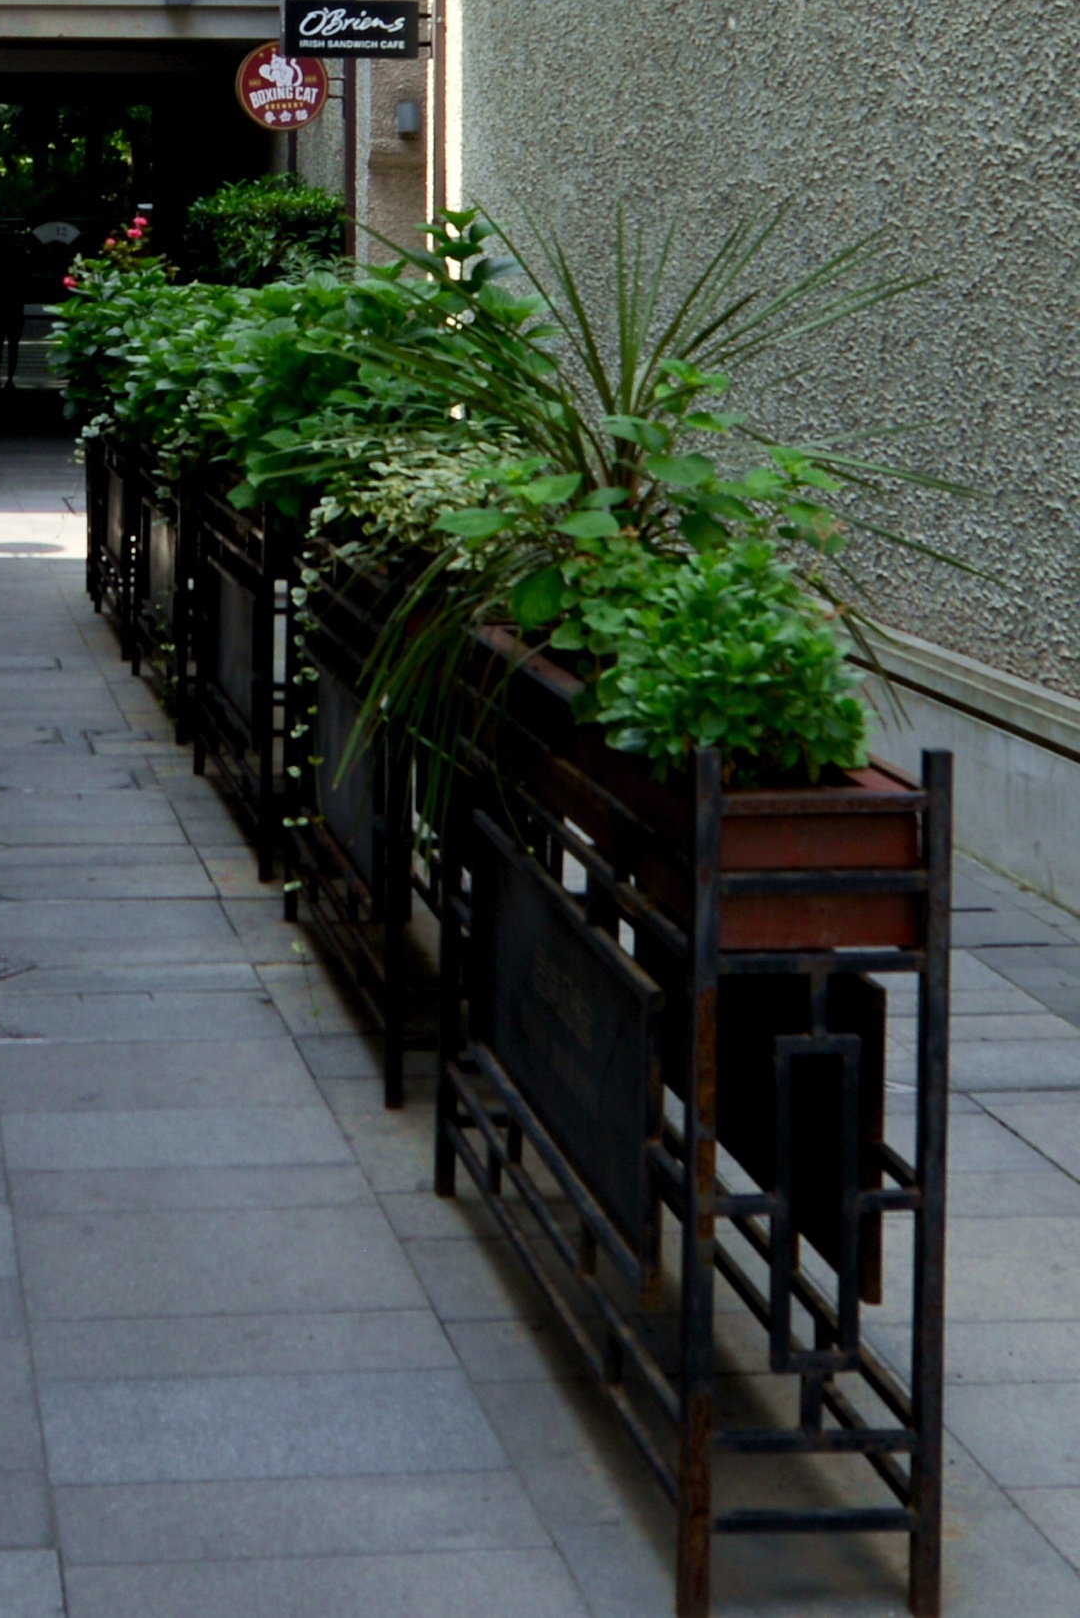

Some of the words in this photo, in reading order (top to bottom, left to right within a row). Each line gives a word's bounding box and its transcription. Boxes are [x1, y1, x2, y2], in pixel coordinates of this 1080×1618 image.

[299, 6, 406, 37] O'Briens
[299, 39, 325, 49] IRISH
[327, 39, 378, 49] SANDWICH
[380, 40, 406, 50] CAFE
[249, 86, 293, 110] BOXING
[295, 86, 319, 105] CAT
[265, 102, 304, 110] BREWERY
